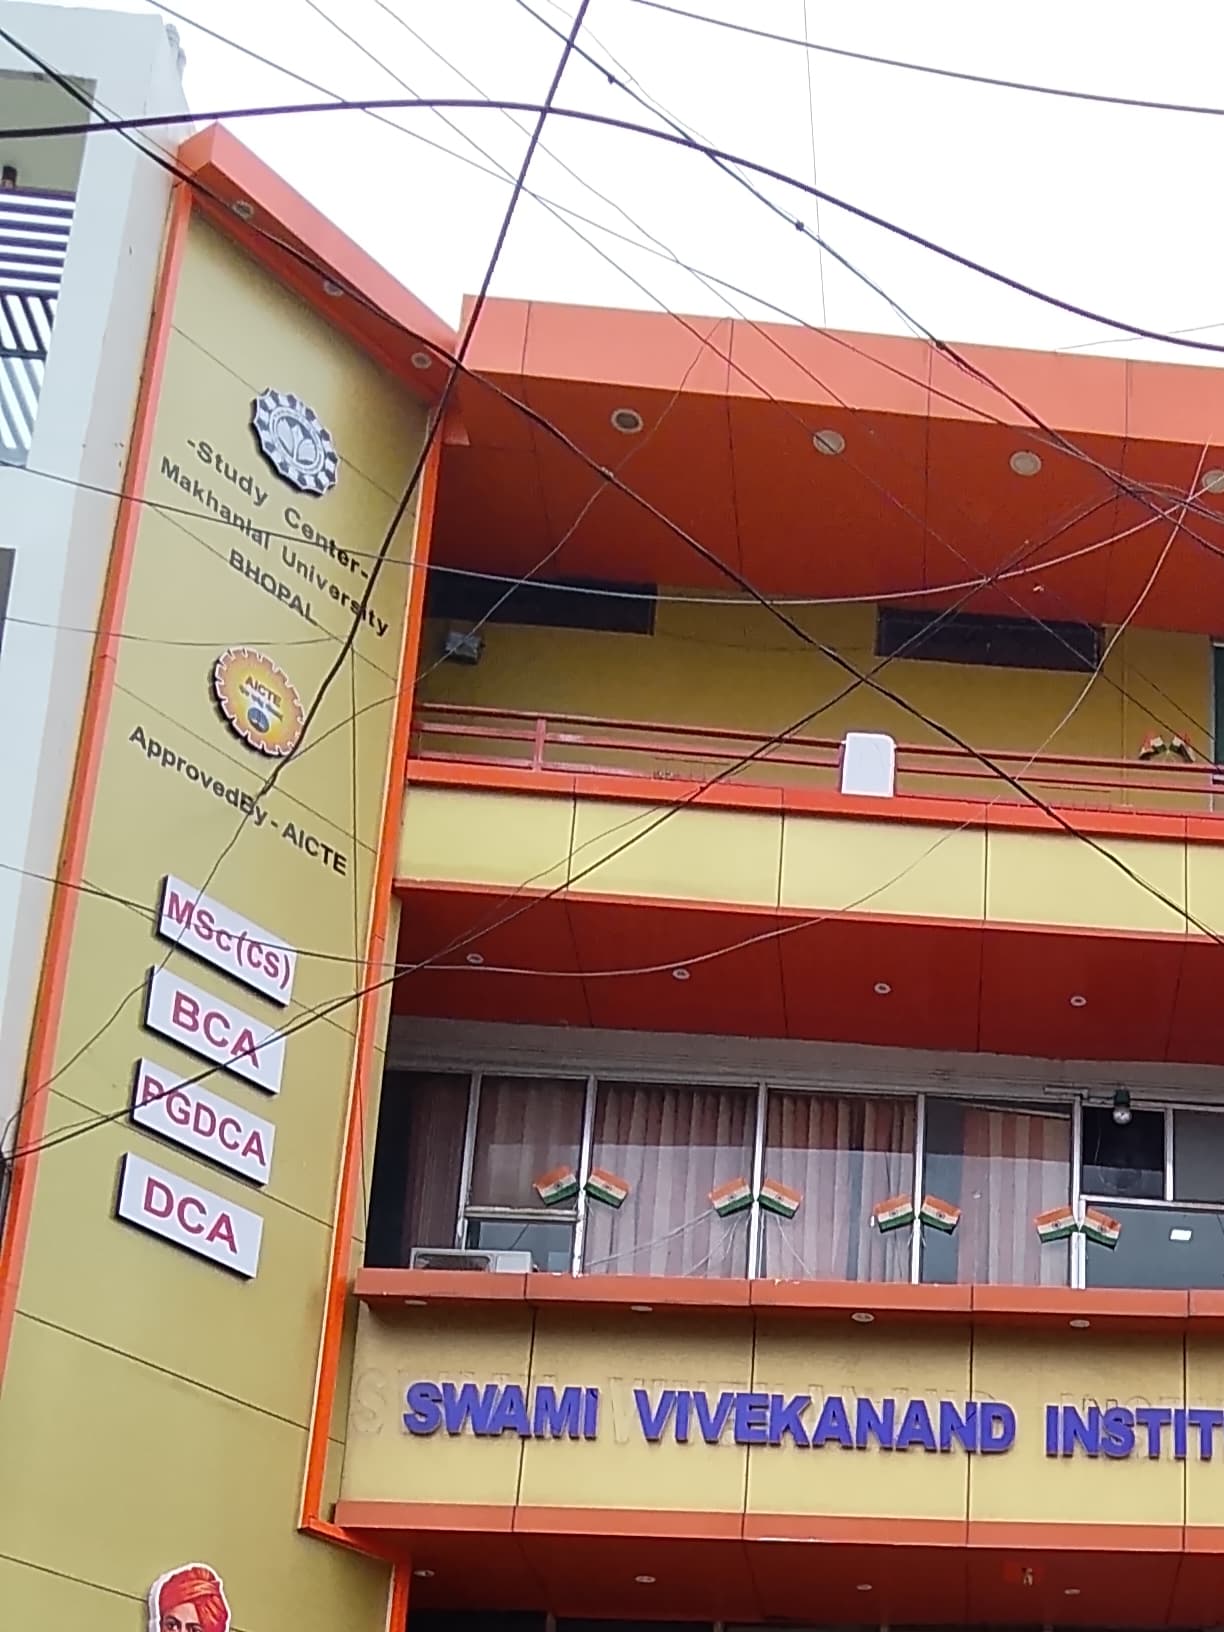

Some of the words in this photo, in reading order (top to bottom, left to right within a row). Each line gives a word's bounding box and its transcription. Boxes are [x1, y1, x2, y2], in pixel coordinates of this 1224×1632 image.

[161, 455, 271, 550] Makhanlal
[281, 545, 389, 637] University
[229, 548, 318, 626] BHOPAL
[281, 821, 348, 876] AICTE
[171, 990, 260, 1069] BCA
[141, 1075, 266, 1167] PGDCA
[143, 1176, 238, 1253] DCA
[403, 1381, 598, 1440] SWAMI
[635, 1389, 1016, 1456] VIVEKANAND
